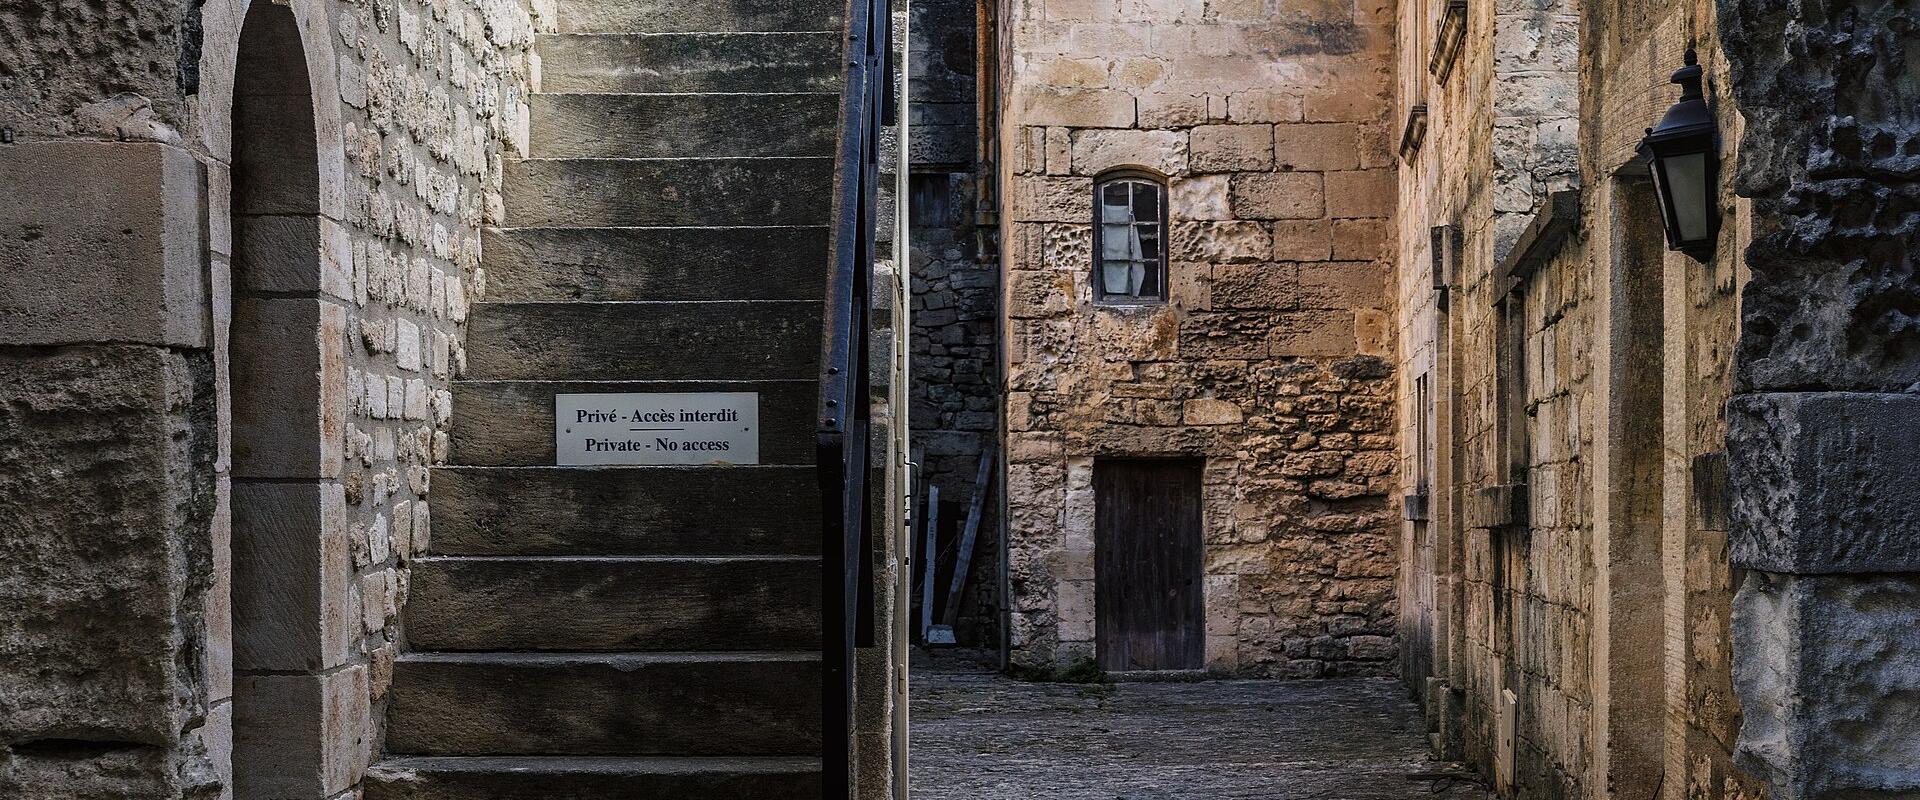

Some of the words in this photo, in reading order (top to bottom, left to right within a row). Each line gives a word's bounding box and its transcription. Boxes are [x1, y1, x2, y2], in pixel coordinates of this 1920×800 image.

[576, 409, 617, 423] Privé
[631, 409, 675, 423] Accès
[679, 408, 738, 422] interdit
[585, 438, 641, 452] Private
[655, 437, 678, 452] No
[682, 441, 730, 452] access
